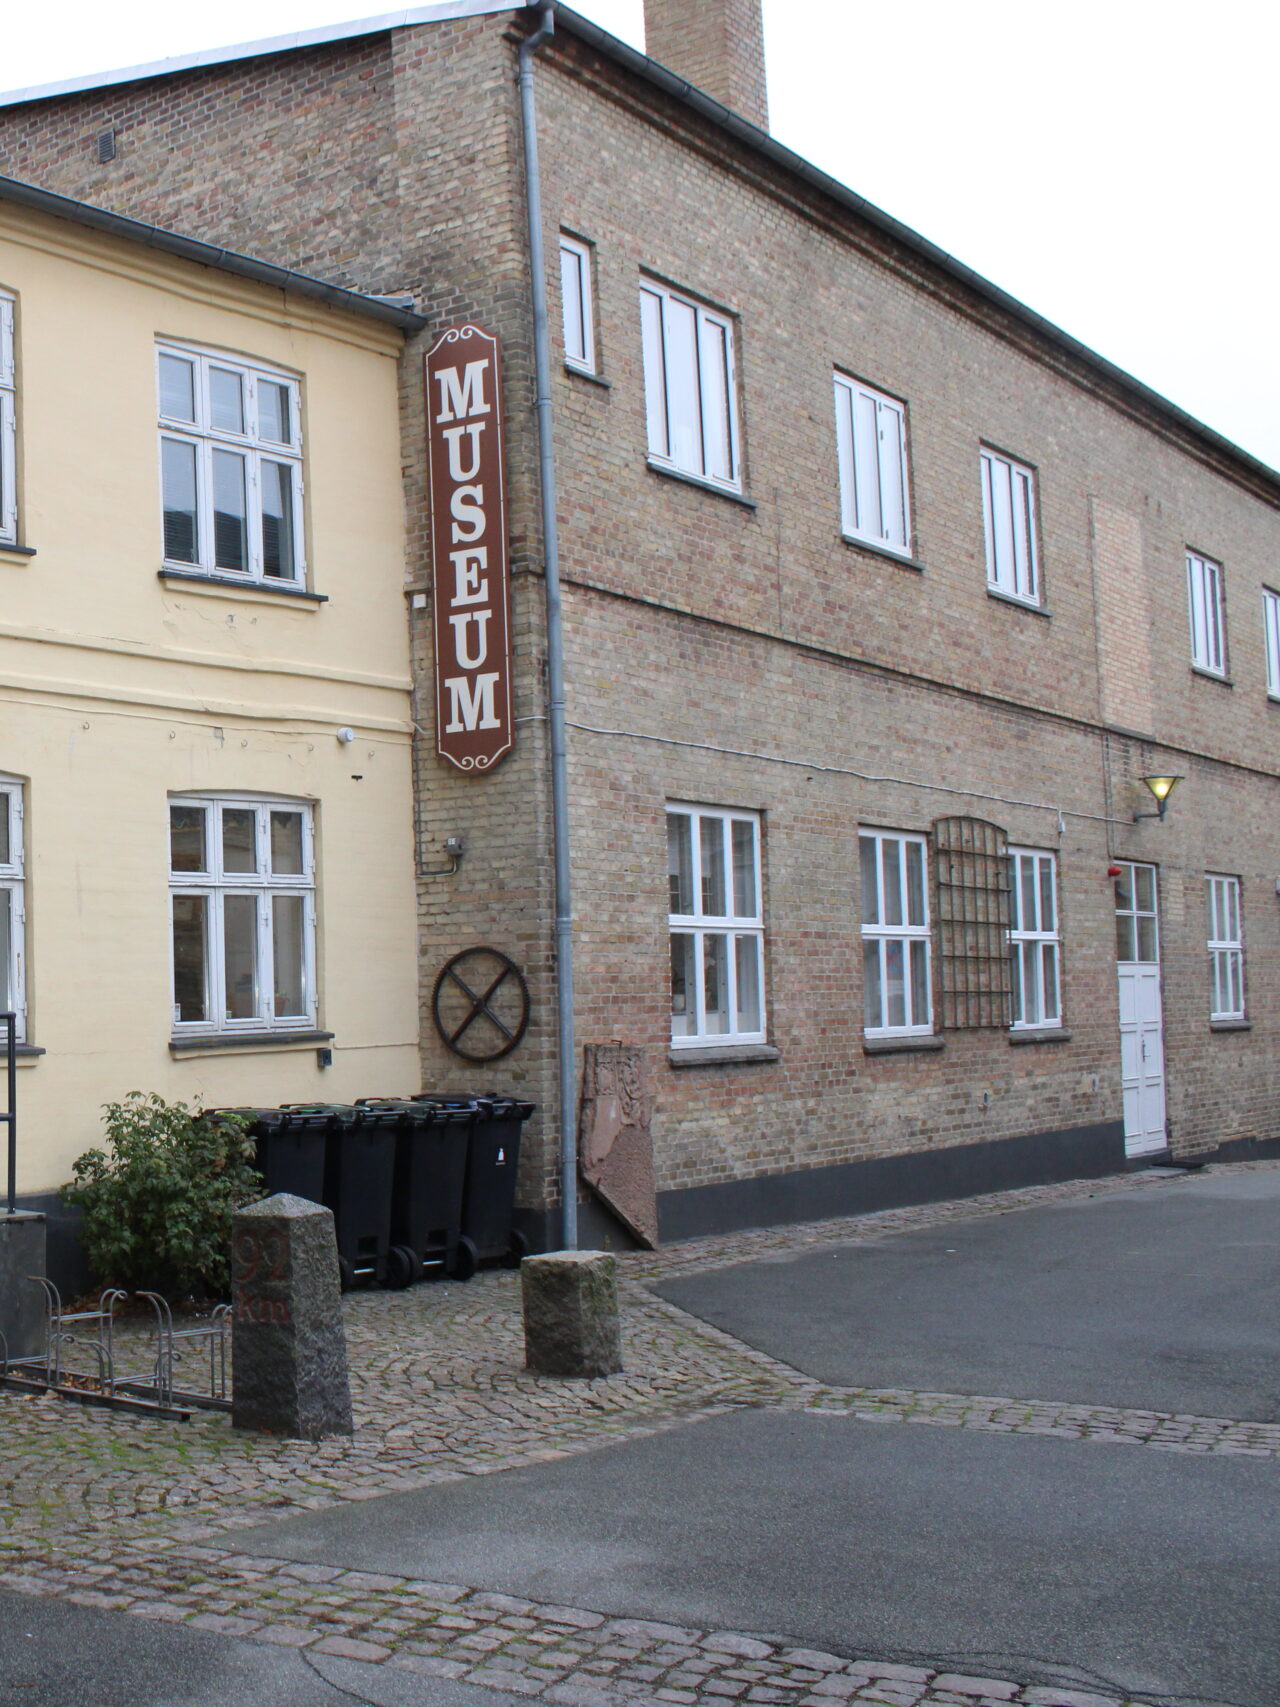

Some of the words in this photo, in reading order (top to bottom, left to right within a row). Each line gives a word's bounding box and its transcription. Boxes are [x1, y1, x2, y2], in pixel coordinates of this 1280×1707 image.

[434, 358, 501, 734] MUSEUM
[235, 1229, 290, 1283] 92
[236, 1288, 291, 1323] km
